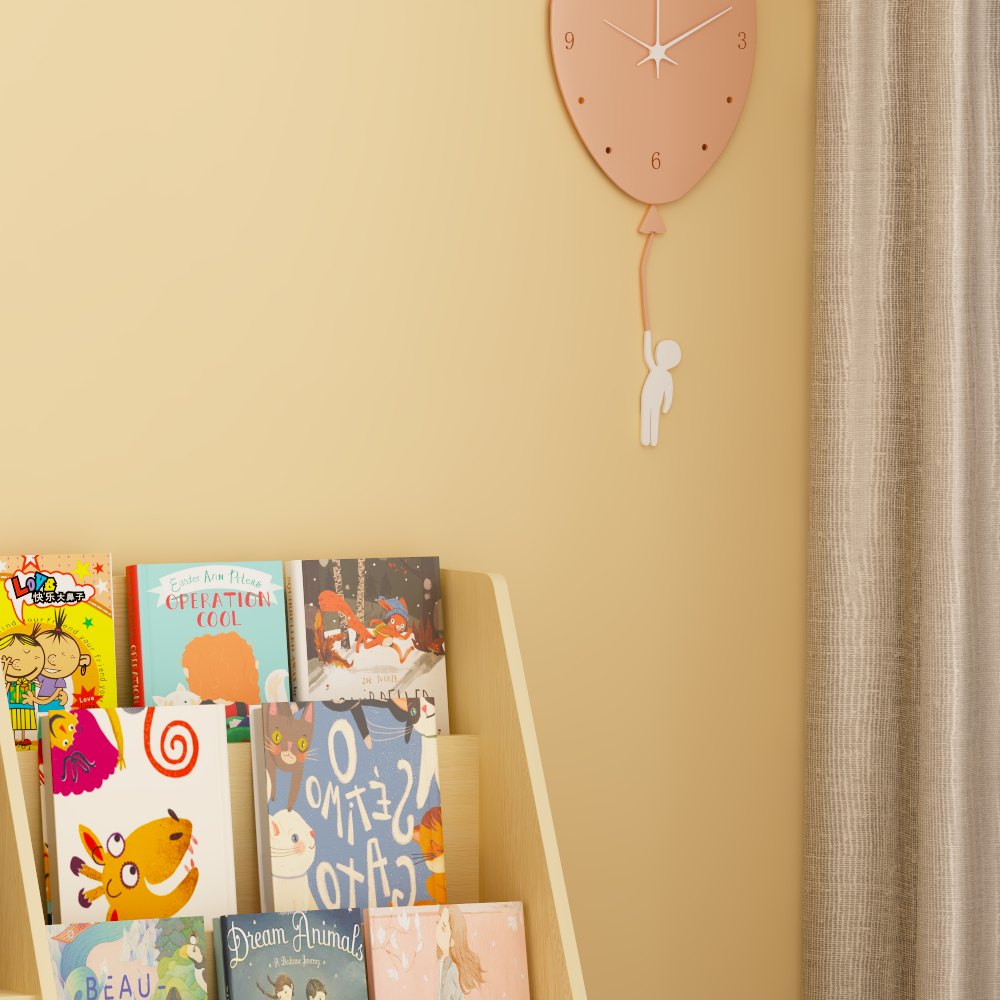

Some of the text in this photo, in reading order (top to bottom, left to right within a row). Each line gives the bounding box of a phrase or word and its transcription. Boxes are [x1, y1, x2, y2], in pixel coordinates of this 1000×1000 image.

[564, 31, 575, 50] 9
[737, 31, 747, 50] 3
[651, 151, 661, 170] 6
[169, 574, 201, 593] Easter
[32, 592, 86, 604] 快乐大鼻子
[165, 591, 271, 610] OPERATION
[196, 610, 242, 628] COOL
[130, 644, 140, 704] OPERATION
[227, 911, 364, 969] Dream Animals
